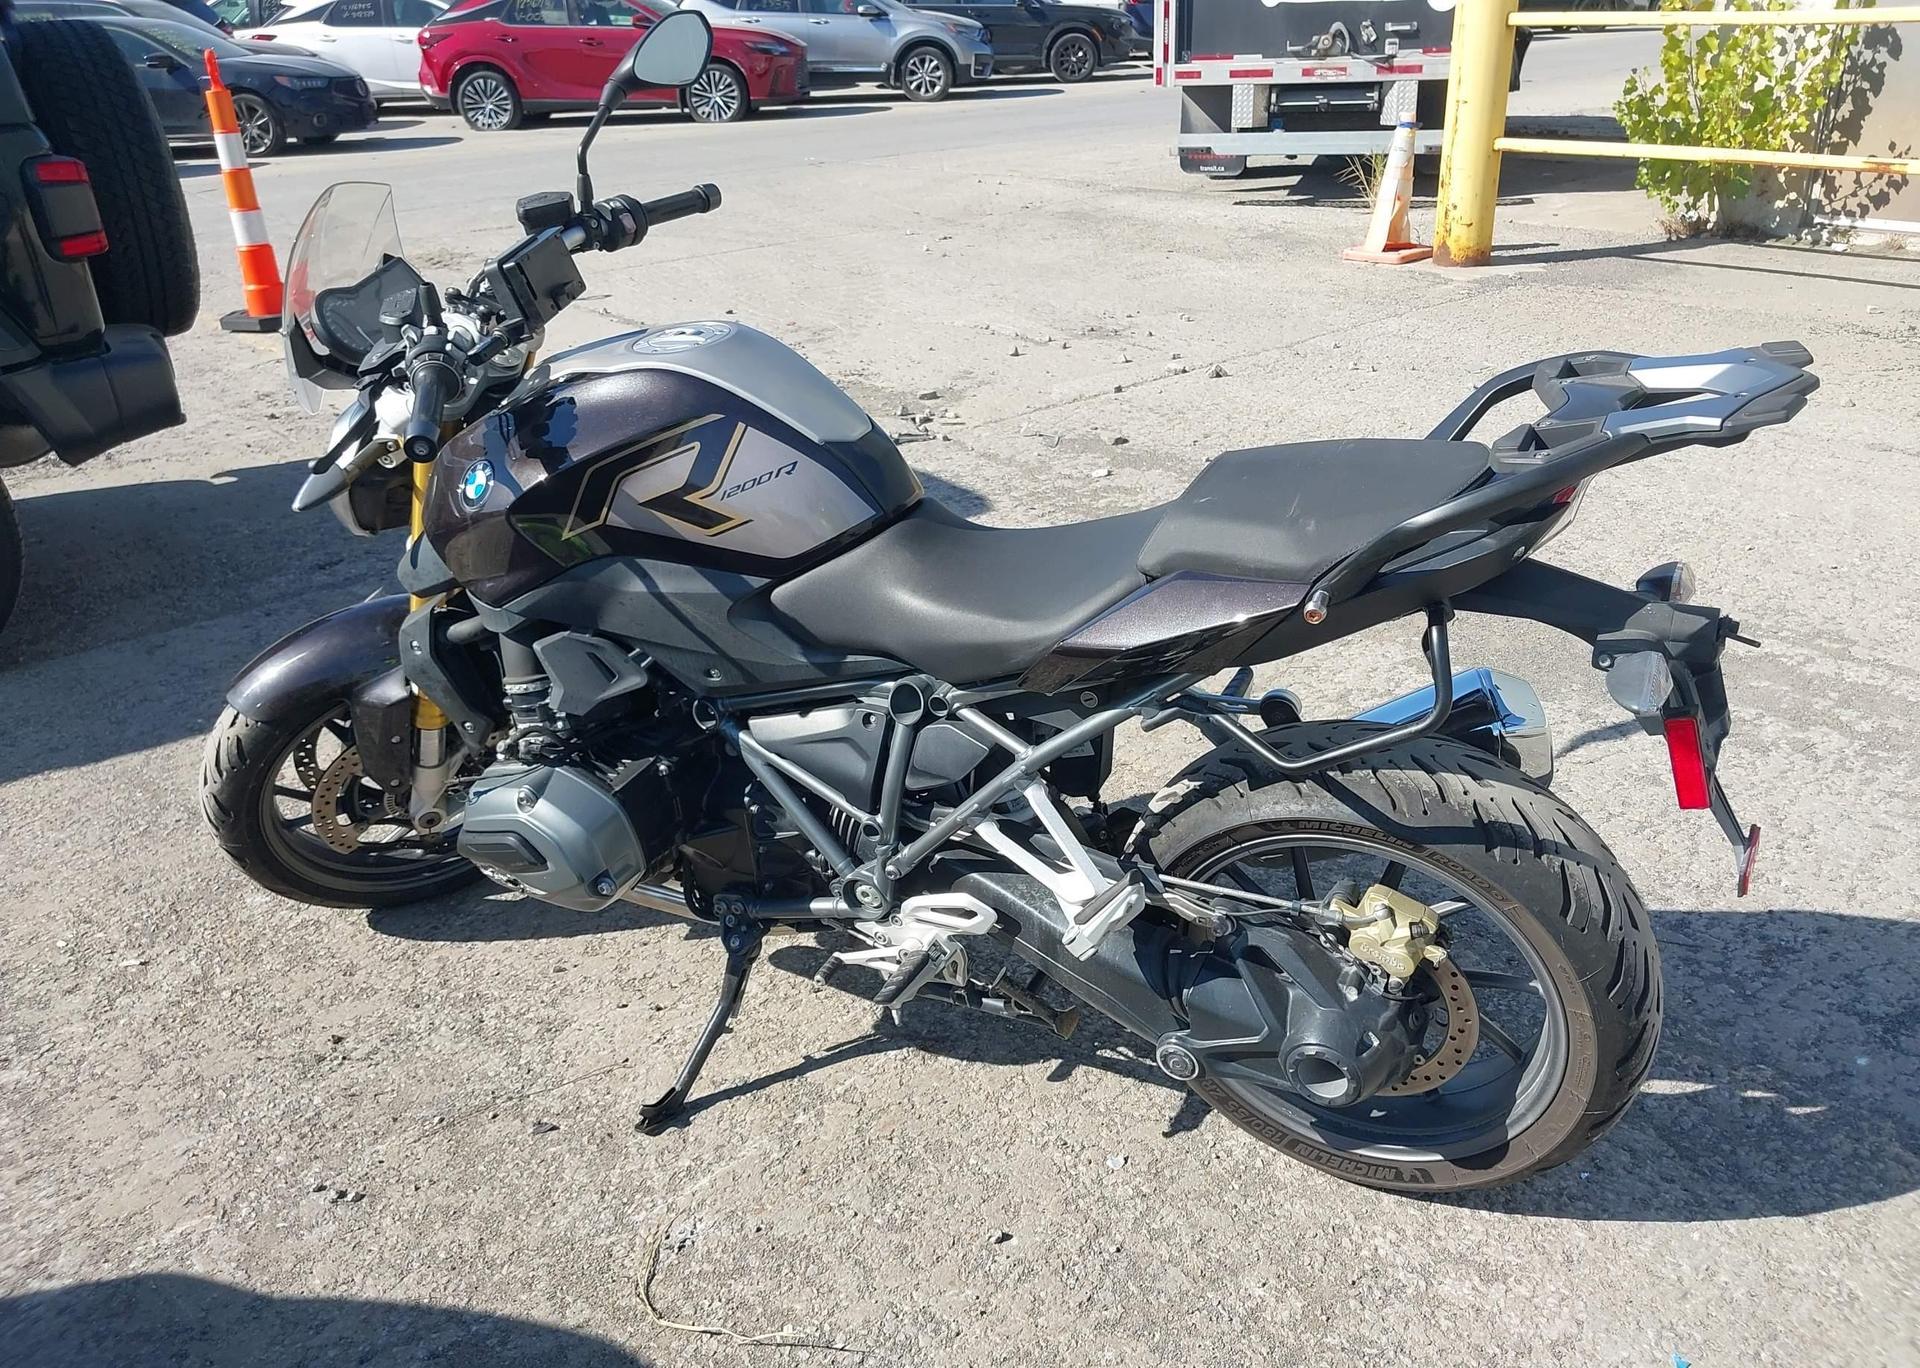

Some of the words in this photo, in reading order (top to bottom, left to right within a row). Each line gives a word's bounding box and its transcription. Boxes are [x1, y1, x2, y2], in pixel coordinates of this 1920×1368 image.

[1299, 820, 1415, 850] MICHELIN
[1433, 854, 1491, 889] ROAD
[1226, 1100, 1286, 1144] 180/55
[1294, 1142, 1397, 1182] MICHELIN
